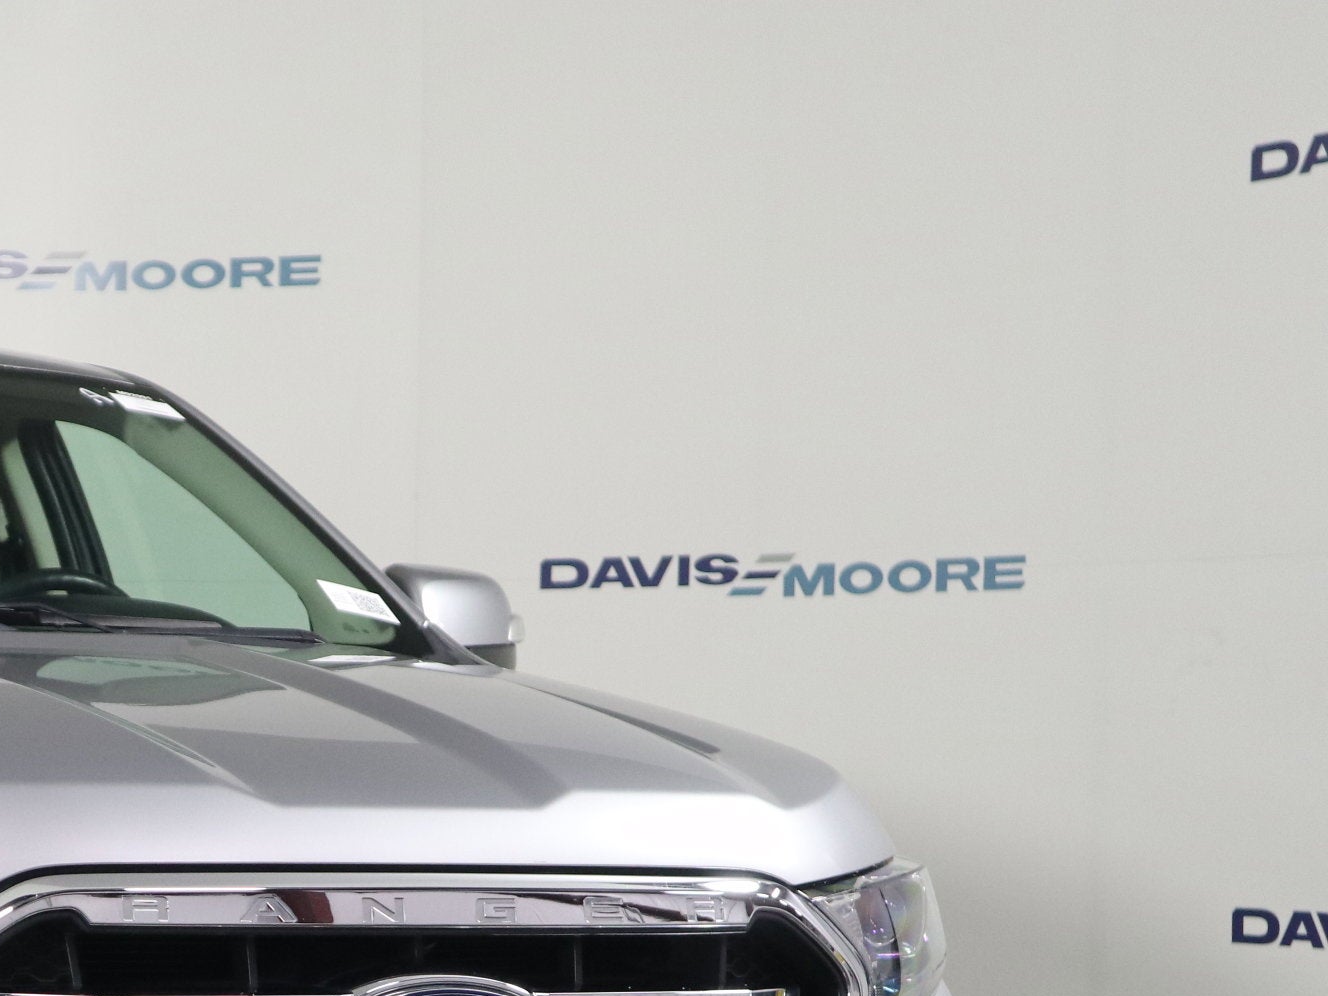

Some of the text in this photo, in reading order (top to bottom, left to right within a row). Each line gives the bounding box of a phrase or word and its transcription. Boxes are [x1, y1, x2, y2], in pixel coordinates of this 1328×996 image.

[75, 254, 322, 291] MOORE
[539, 553, 1027, 597] DAVIS MOORE
[122, 894, 726, 924] RANGER
